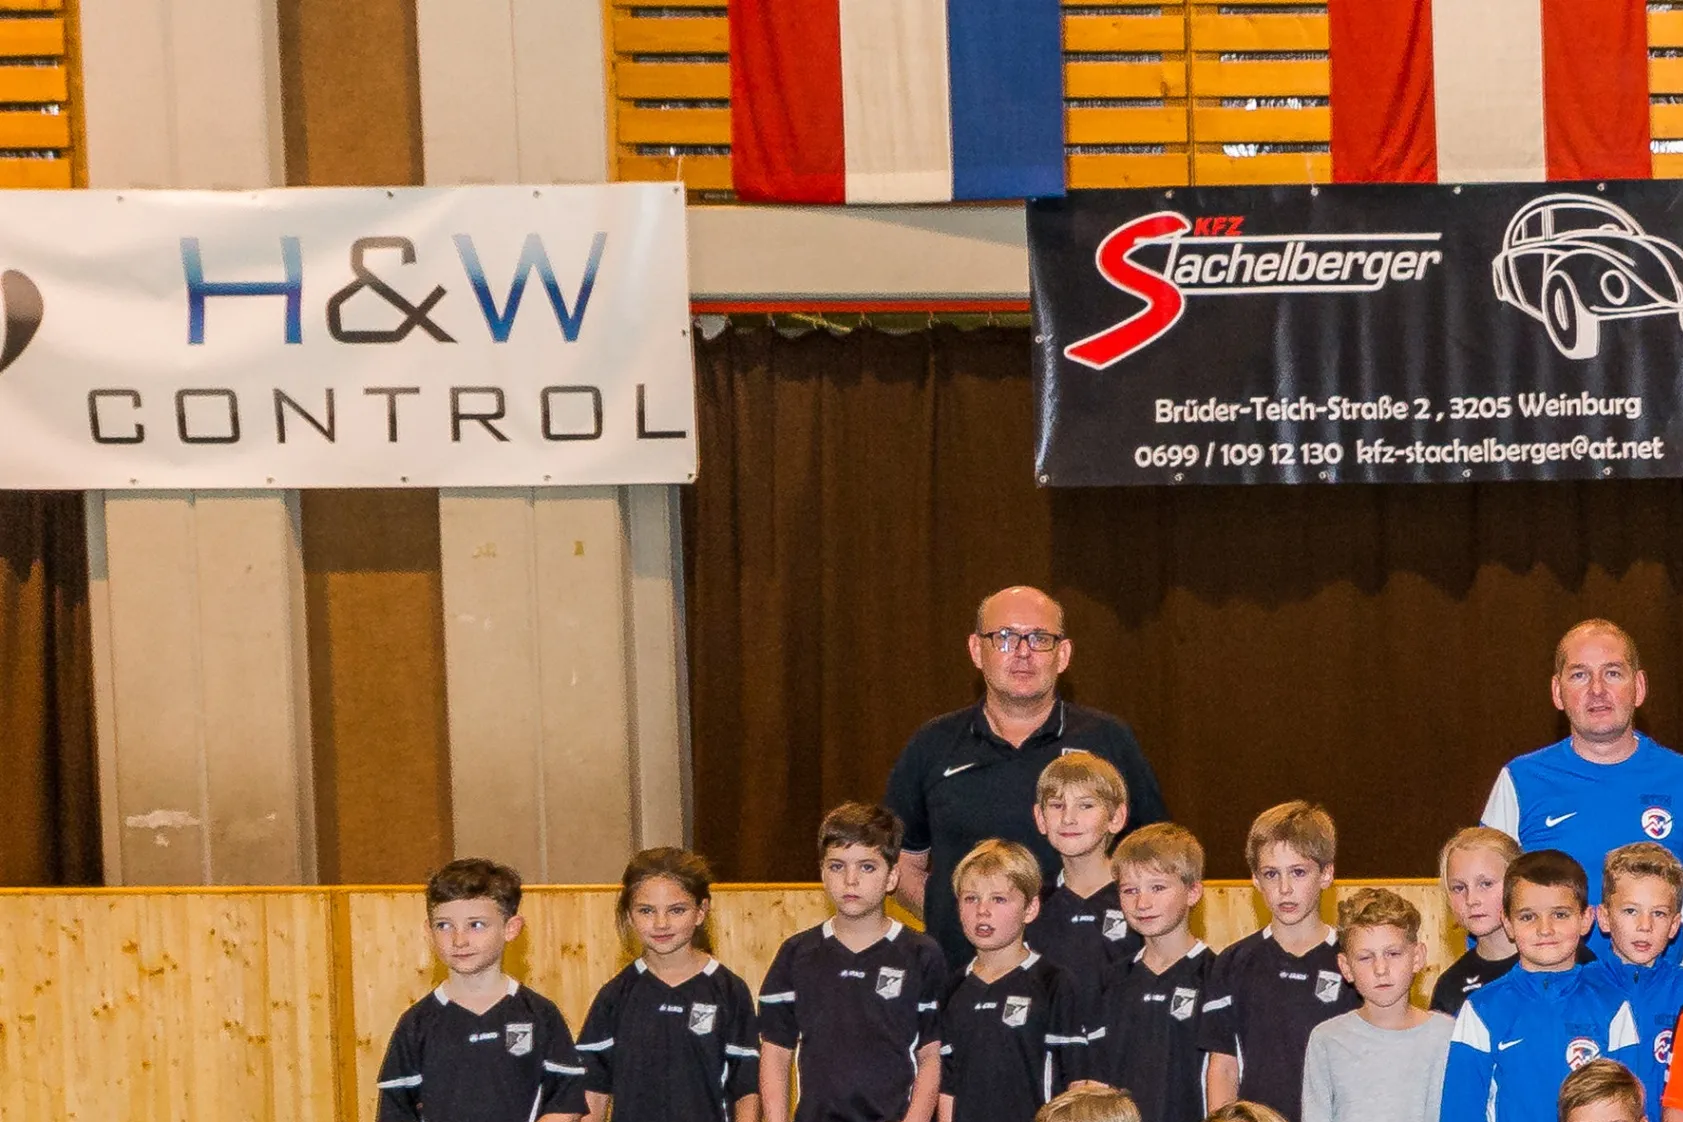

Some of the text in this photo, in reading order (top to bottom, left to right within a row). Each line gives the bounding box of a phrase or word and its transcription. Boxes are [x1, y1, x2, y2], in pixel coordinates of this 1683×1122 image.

[1193, 215, 1245, 238] KFZ
[180, 231, 608, 346] H&W
[1064, 210, 1442, 369] Stachelberger
[87, 382, 687, 445] CONTROL
[1154, 396, 1408, 424] Brüder-Teich-Straße
[1450, 396, 1511, 418] 3205
[1518, 391, 1642, 420] Weinburg
[1134, 443, 1198, 468] 0699
[1220, 442, 1265, 467] 109
[1270, 442, 1296, 466] 12
[1302, 441, 1344, 465] 130
[1356, 434, 1664, 464] kfz-stachelberger@at.net
